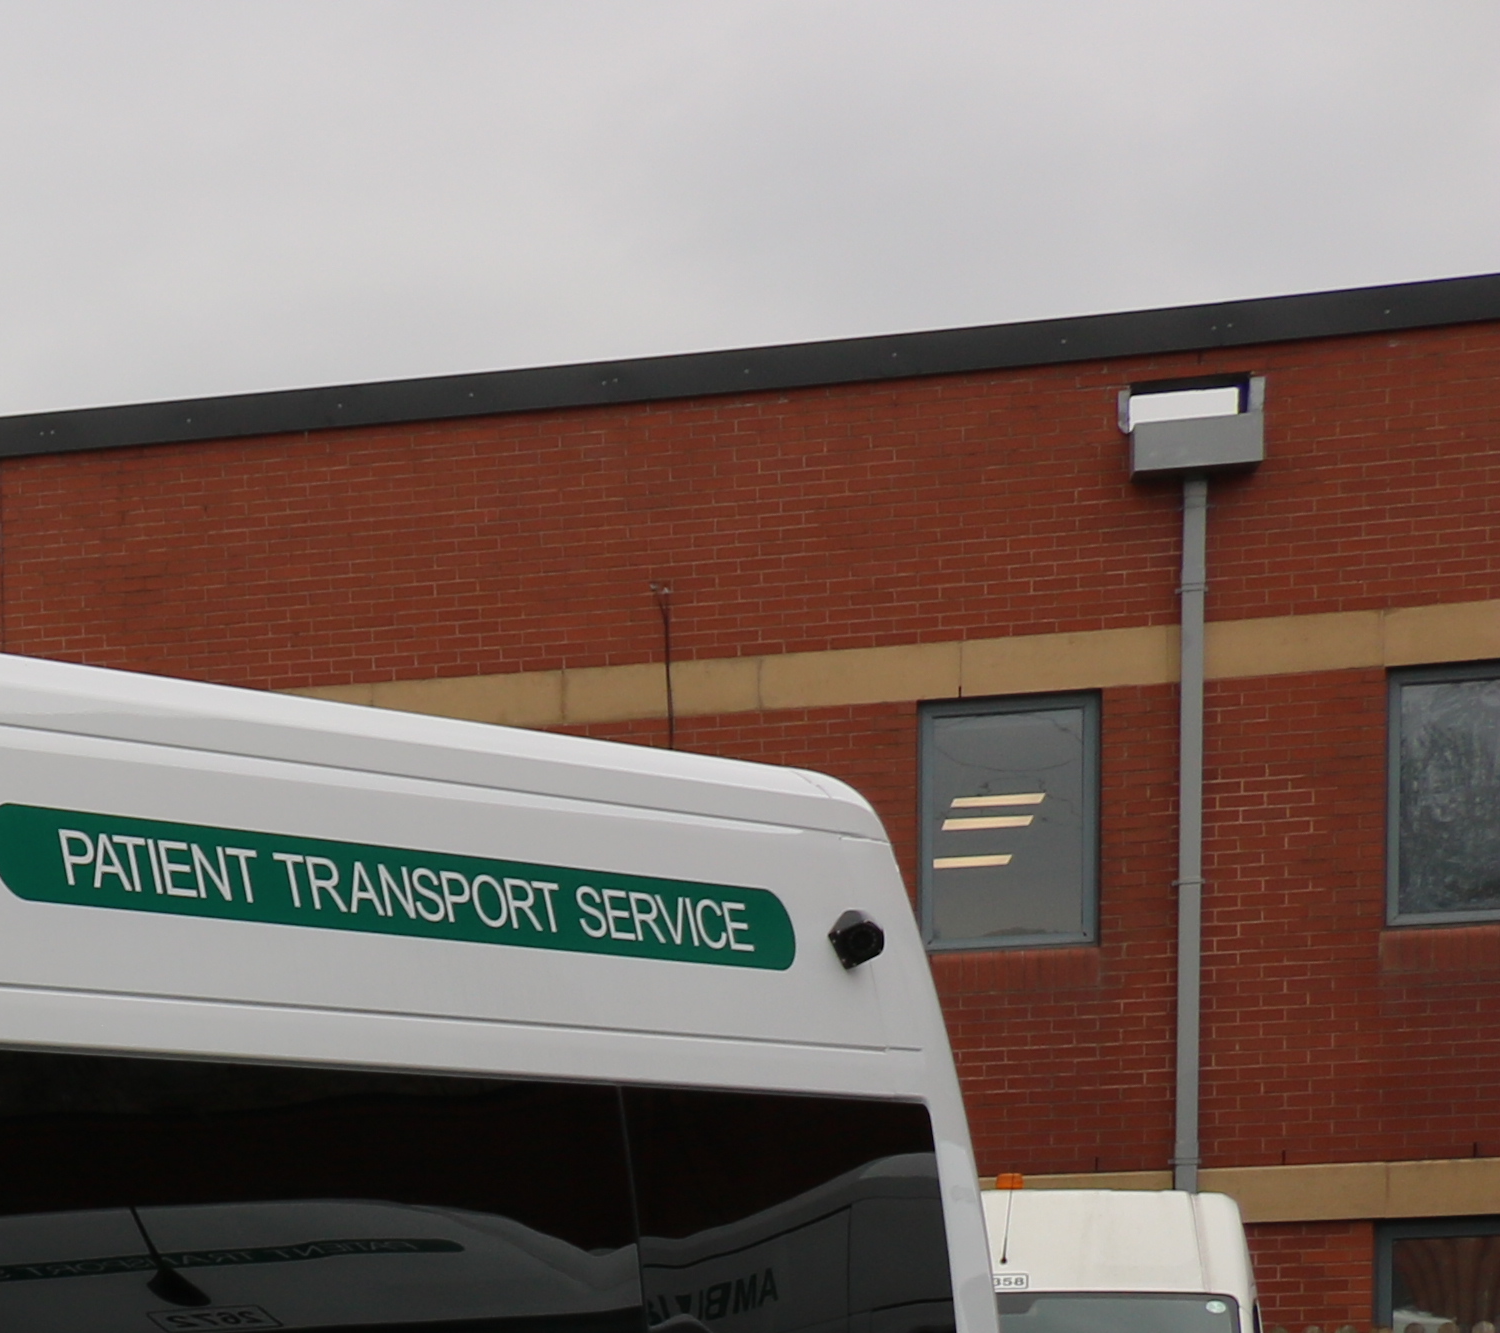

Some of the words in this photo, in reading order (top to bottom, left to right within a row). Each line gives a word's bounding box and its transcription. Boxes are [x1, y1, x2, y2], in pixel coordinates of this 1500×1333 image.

[59, 828, 257, 905] PATIENT
[274, 852, 559, 934] TRANSPORT
[579, 886, 756, 953] SERVICE
